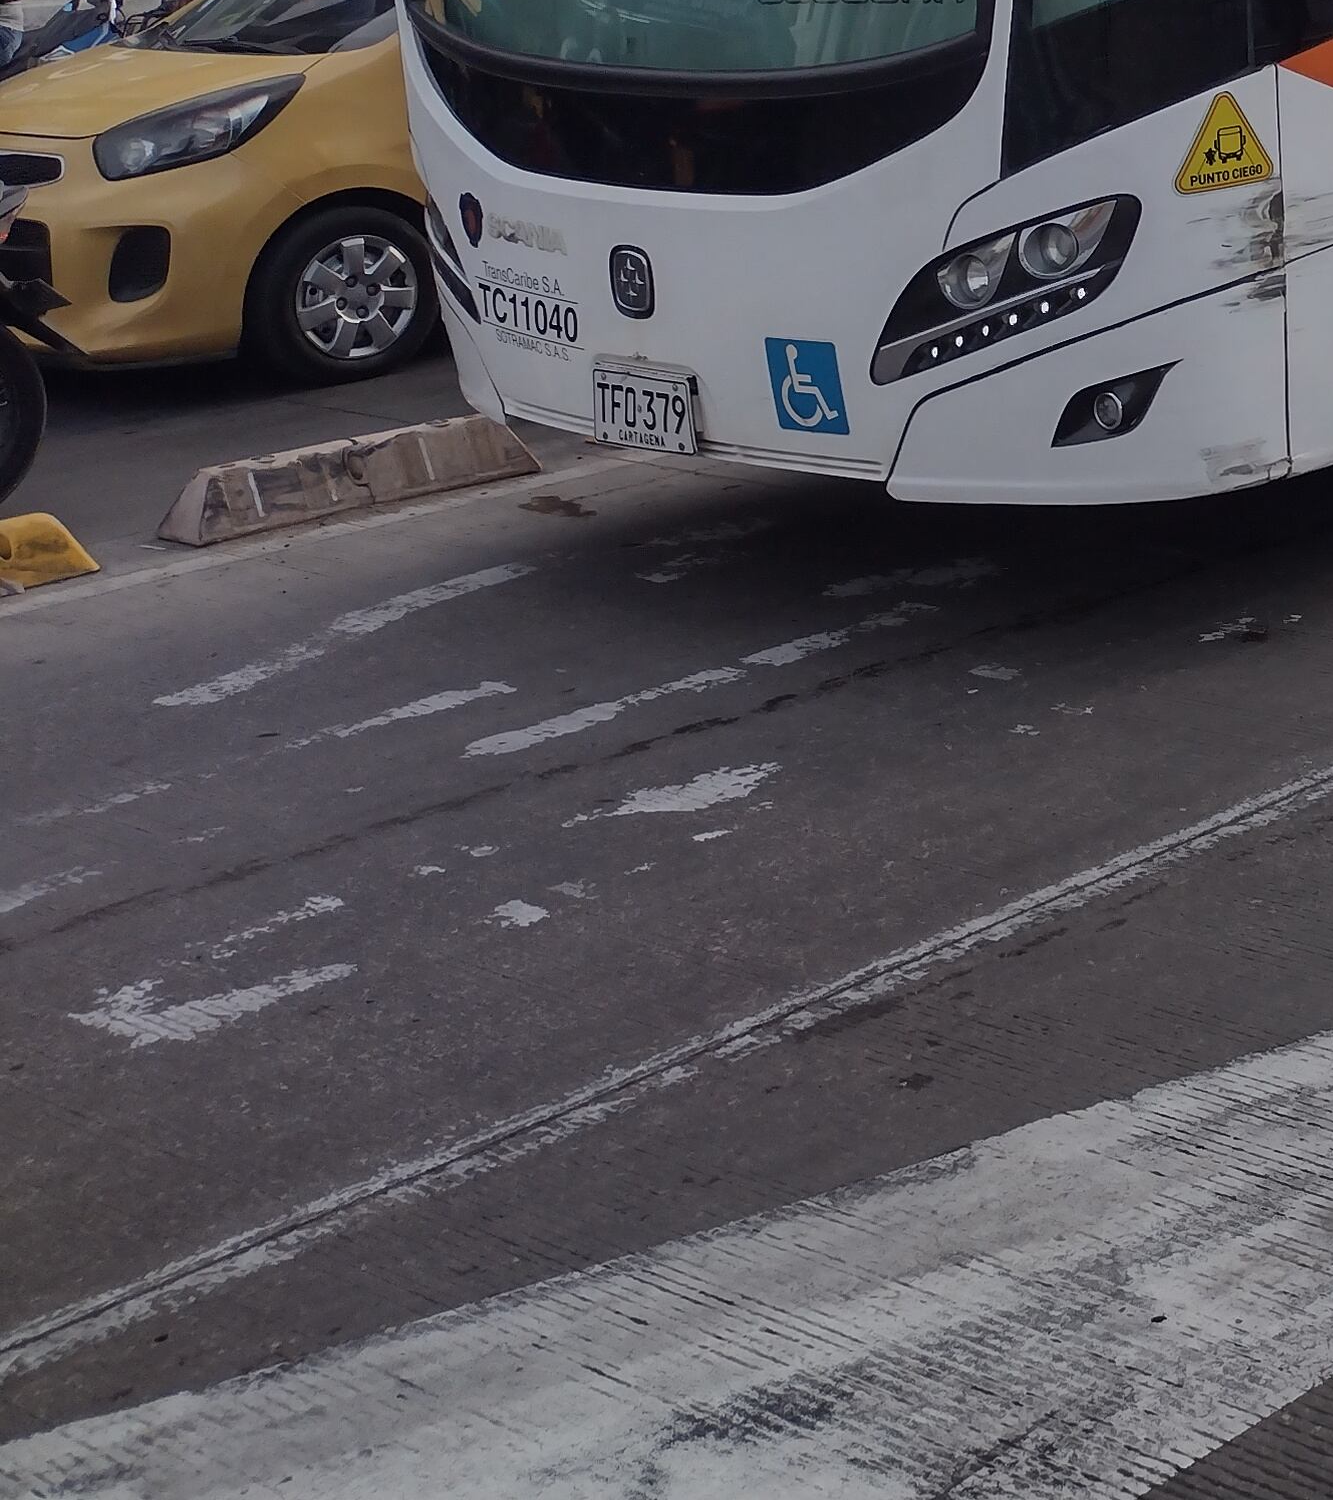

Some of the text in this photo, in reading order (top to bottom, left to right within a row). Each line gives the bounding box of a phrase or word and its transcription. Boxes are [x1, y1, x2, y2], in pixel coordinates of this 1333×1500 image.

[1190, 163, 1263, 187] PUNTO CIEGO
[482, 260, 565, 297] TransCaribe S.A.
[478, 282, 578, 343] TC11040
[618, 429, 666, 448] CARTAGENA
